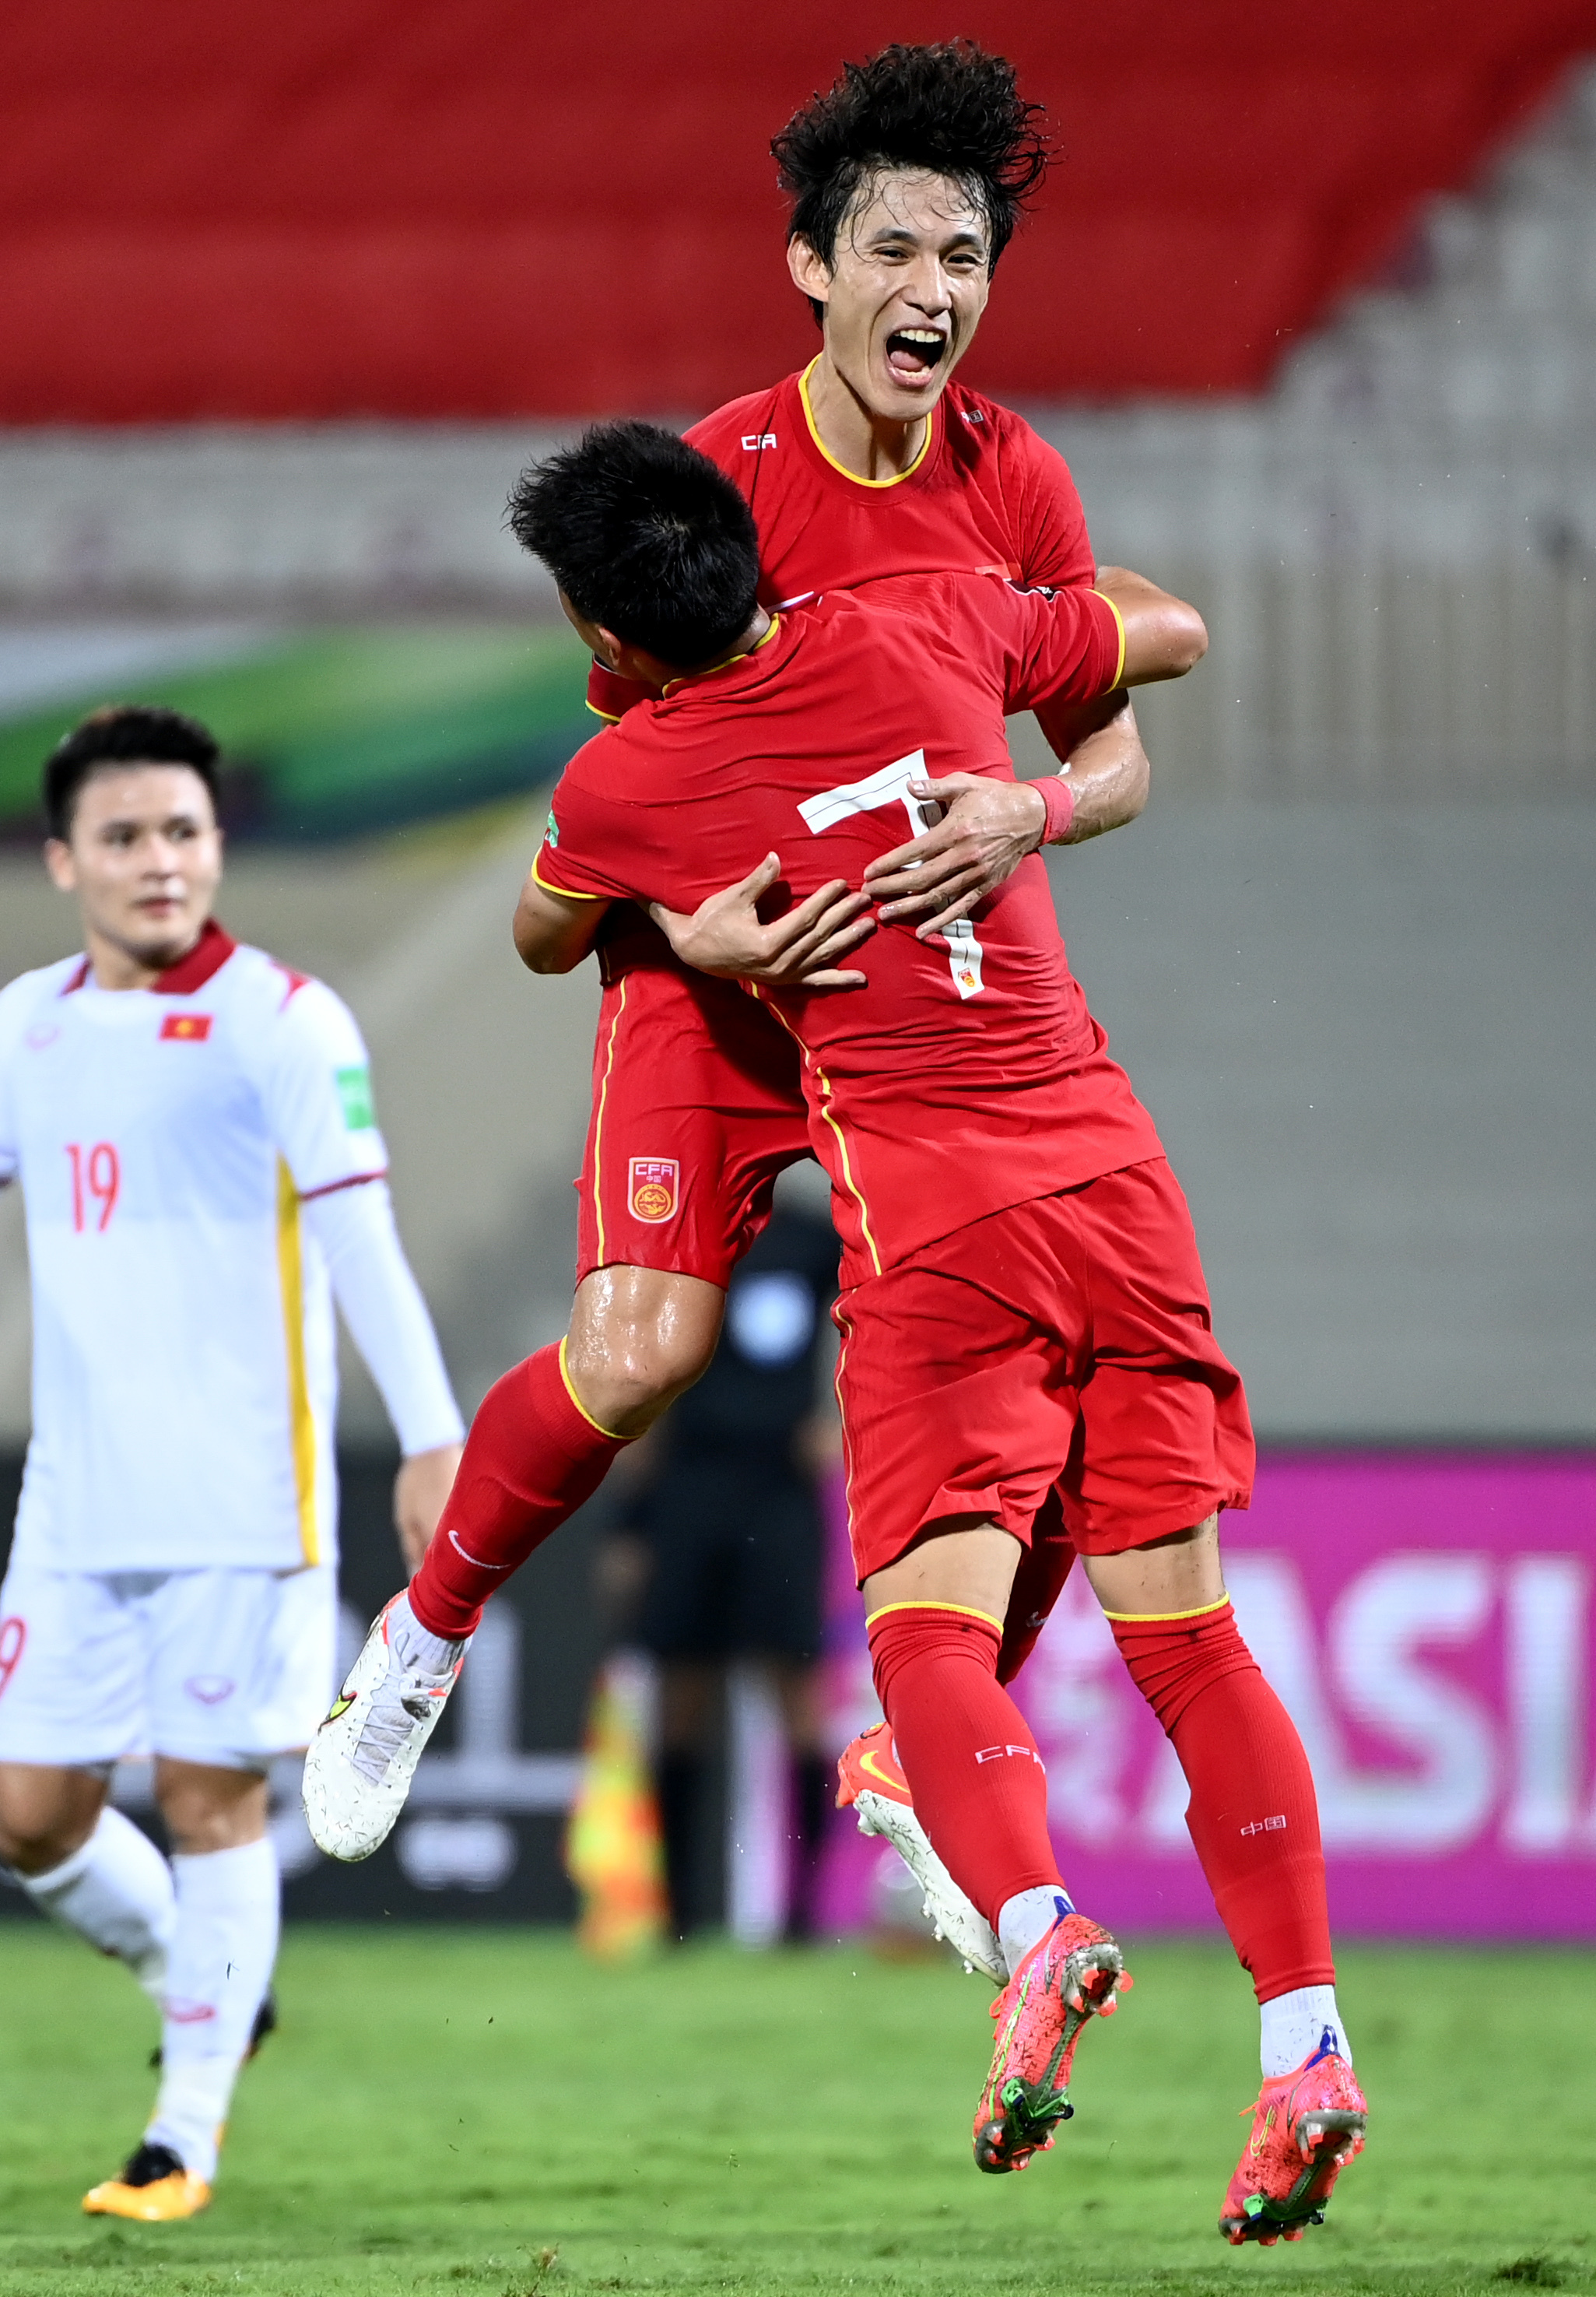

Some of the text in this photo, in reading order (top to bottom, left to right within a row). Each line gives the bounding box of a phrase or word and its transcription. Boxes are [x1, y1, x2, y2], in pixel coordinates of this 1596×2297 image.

[797, 748, 984, 999] 7
[65, 1143, 120, 1233] 19
[635, 1163, 673, 1176] CFA
[1140, 1551, 1596, 1851] ASI
[1240, 1814, 1286, 1836] 中国
